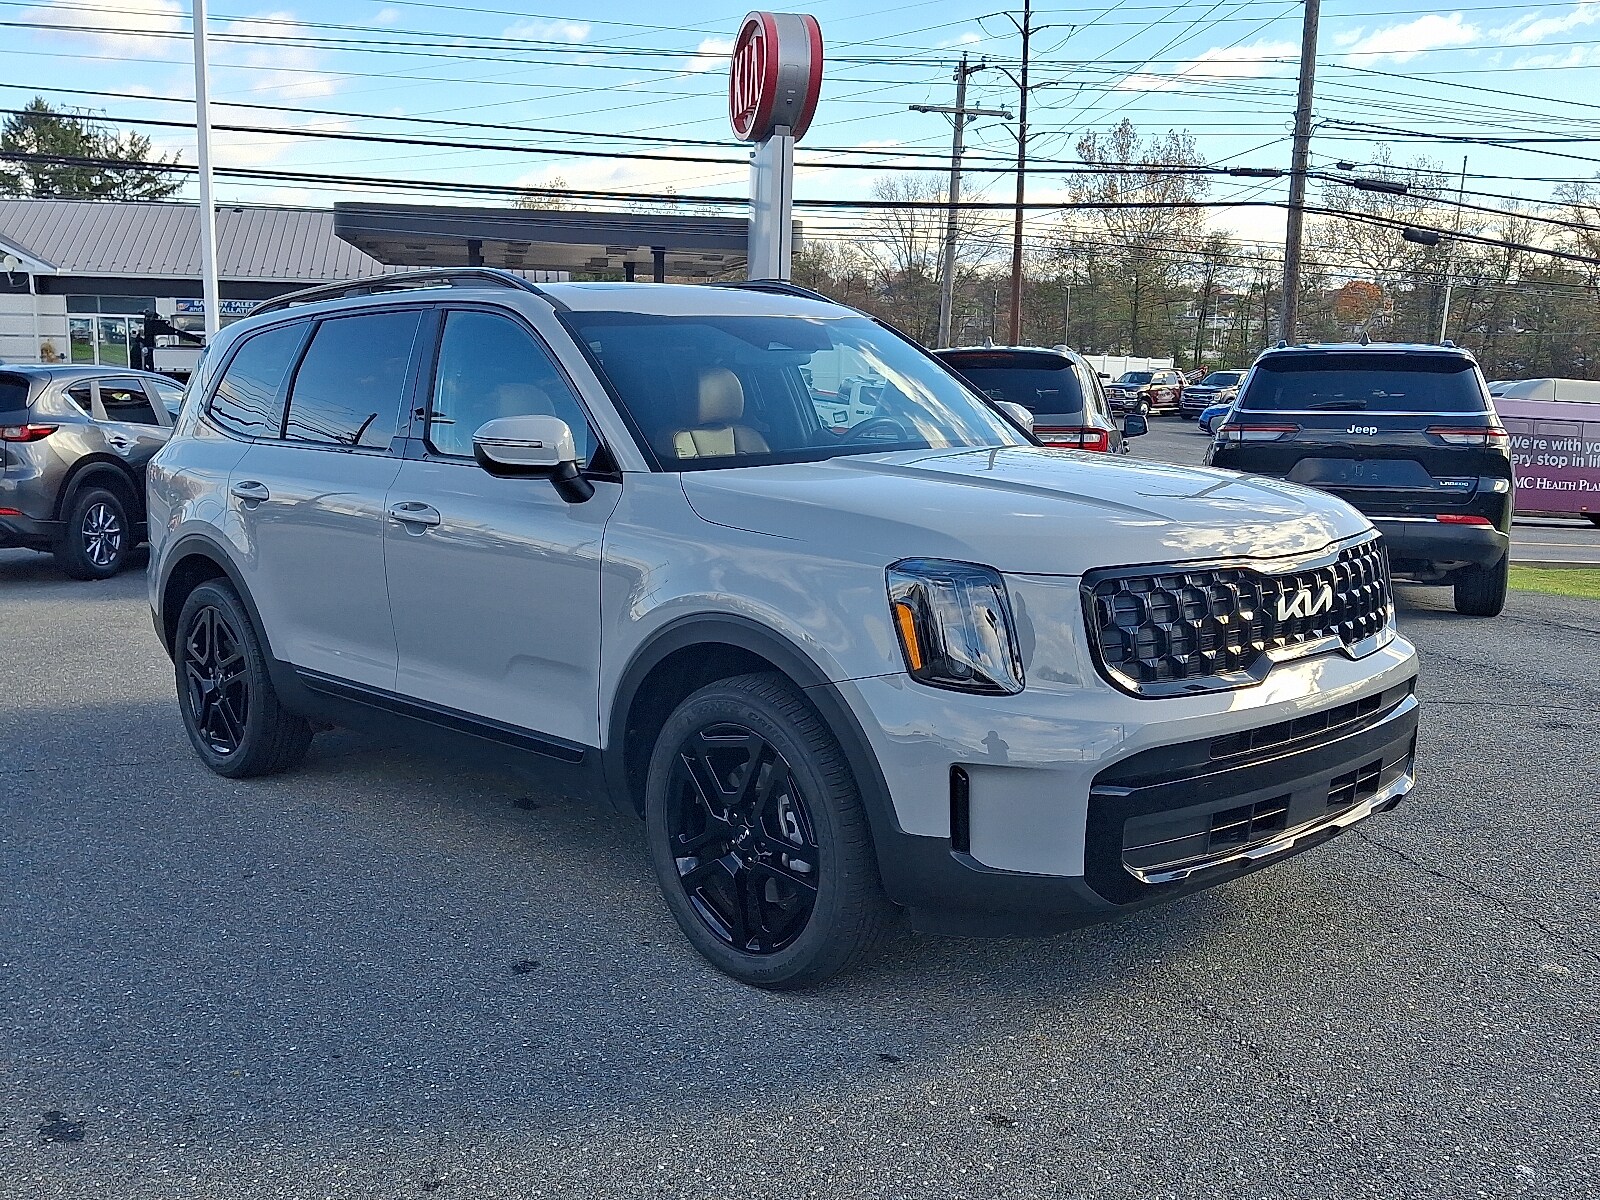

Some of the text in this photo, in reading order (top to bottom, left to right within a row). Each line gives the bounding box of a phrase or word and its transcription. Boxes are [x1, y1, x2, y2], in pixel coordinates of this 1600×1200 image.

[734, 36, 759, 118] KIA
[1347, 425, 1378, 436] Jeep
[1510, 436, 1600, 455] We're with yo
[1511, 453, 1600, 469] ery stop in lif
[1514, 476, 1534, 489] MC
[1578, 479, 1600, 492] PLA
[1277, 584, 1333, 621] KIA
